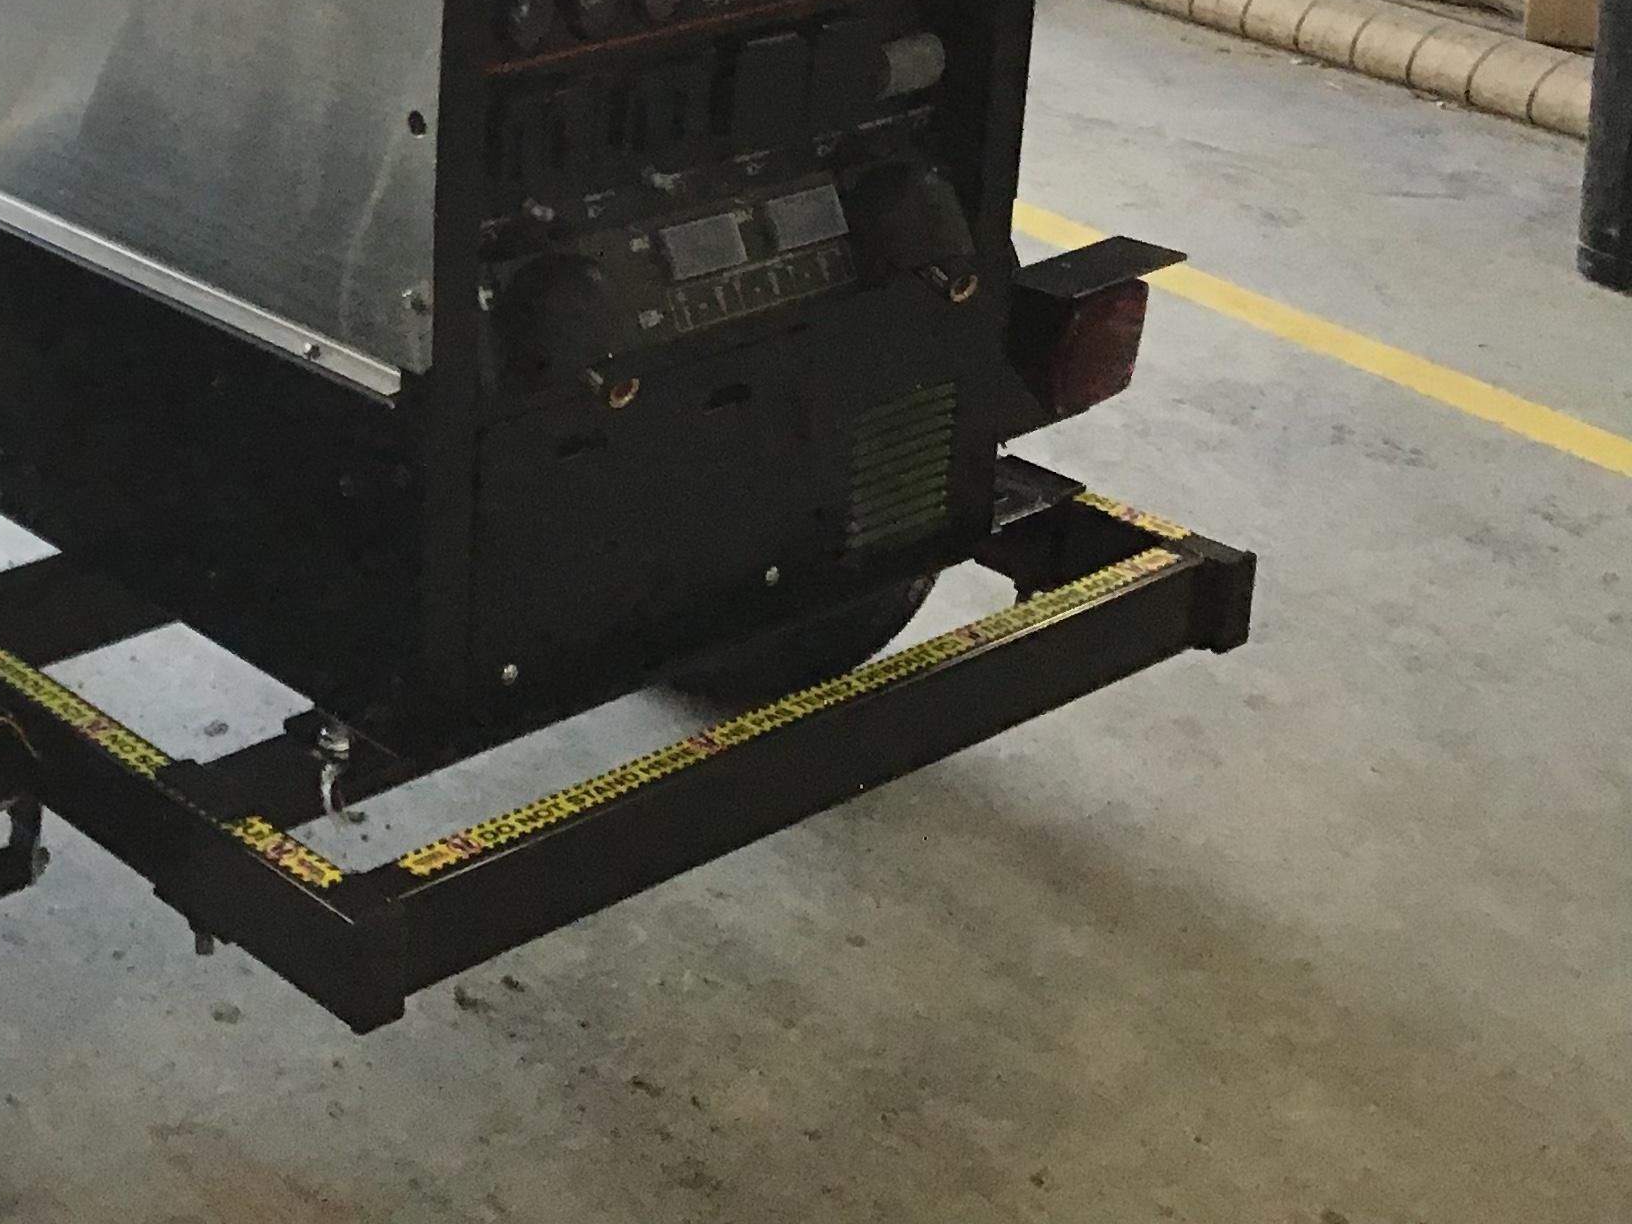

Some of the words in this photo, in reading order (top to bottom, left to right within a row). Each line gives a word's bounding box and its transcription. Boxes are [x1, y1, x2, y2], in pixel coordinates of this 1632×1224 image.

[477, 823, 518, 842] DO
[514, 802, 565, 823] NOT
[565, 771, 641, 805] STAND
